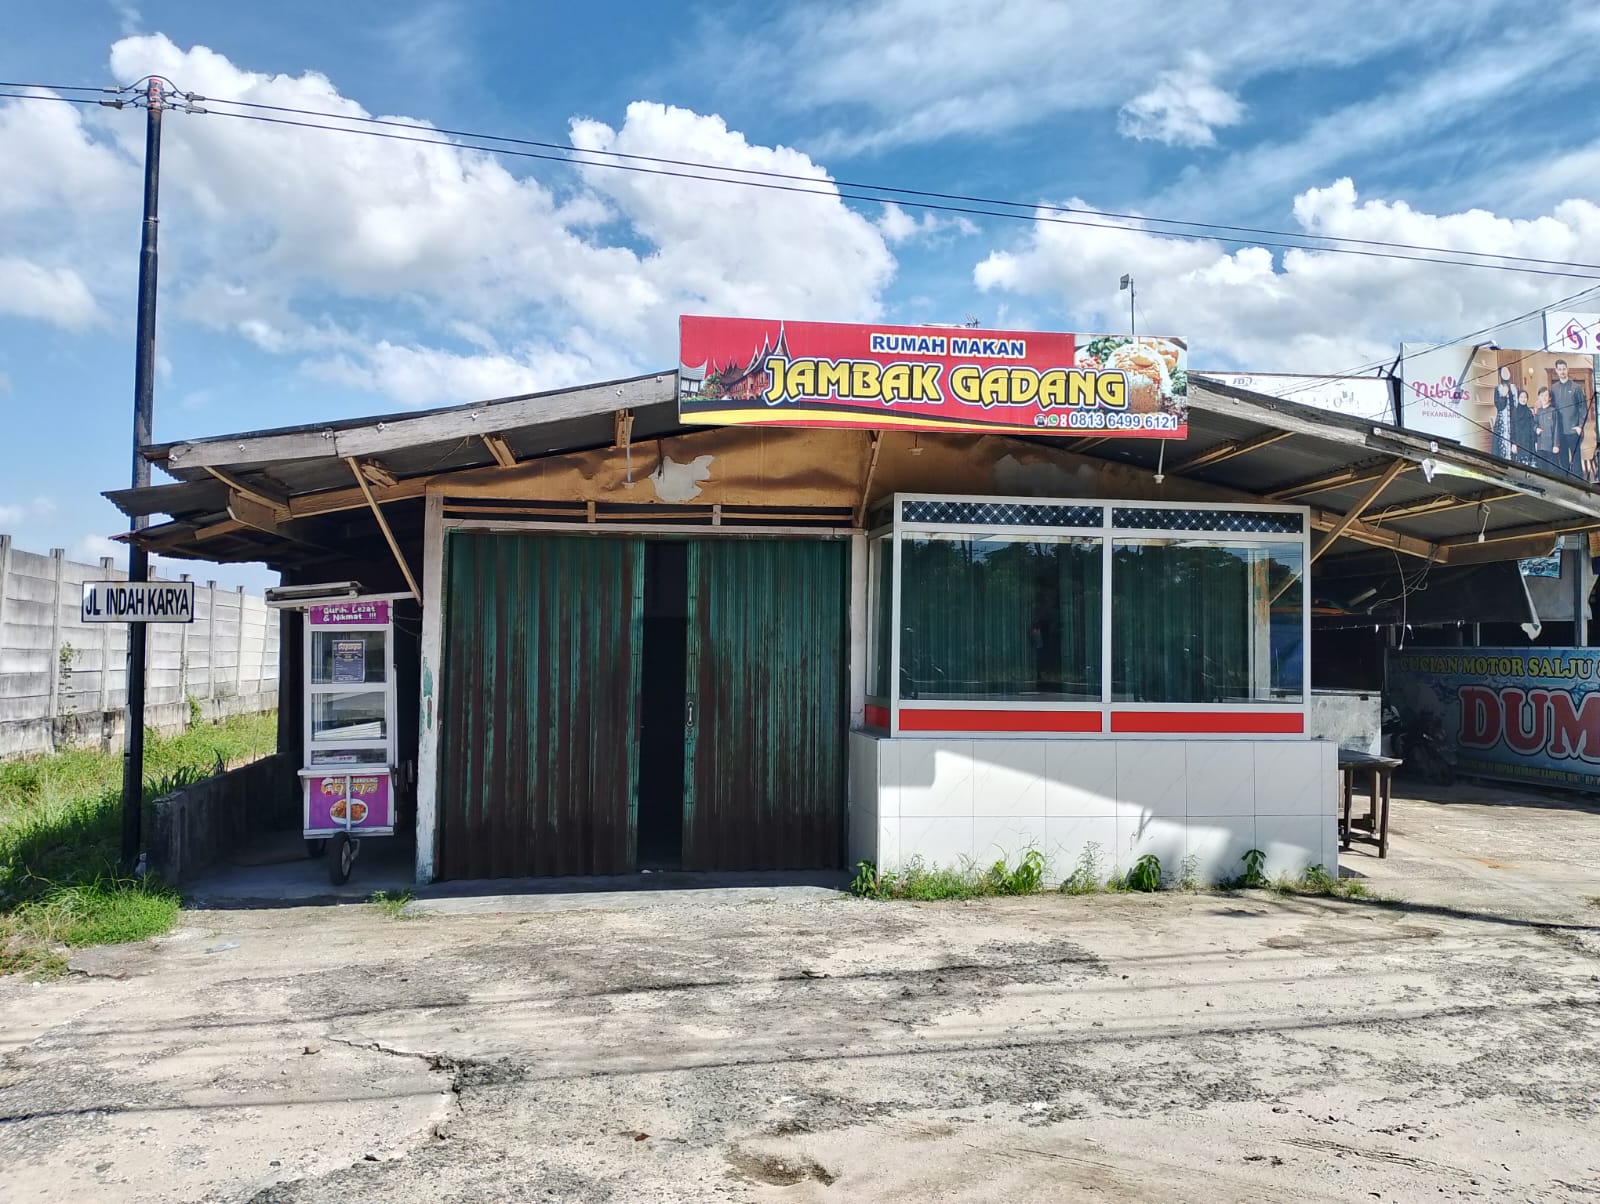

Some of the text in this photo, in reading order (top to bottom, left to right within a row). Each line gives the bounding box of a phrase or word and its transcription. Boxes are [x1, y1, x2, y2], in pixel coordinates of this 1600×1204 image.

[870, 333, 1025, 357] RUMAH MAKAN
[767, 358, 1128, 411] JAMBAK GADANG
[1070, 414, 1104, 427] 0813
[1108, 414, 1141, 427] 6499
[1145, 416, 1177, 429] 6121
[86, 588, 190, 615] JL INDAH KARYA
[1462, 656, 1525, 677] MOTOR
[1528, 657, 1593, 679] SALJU
